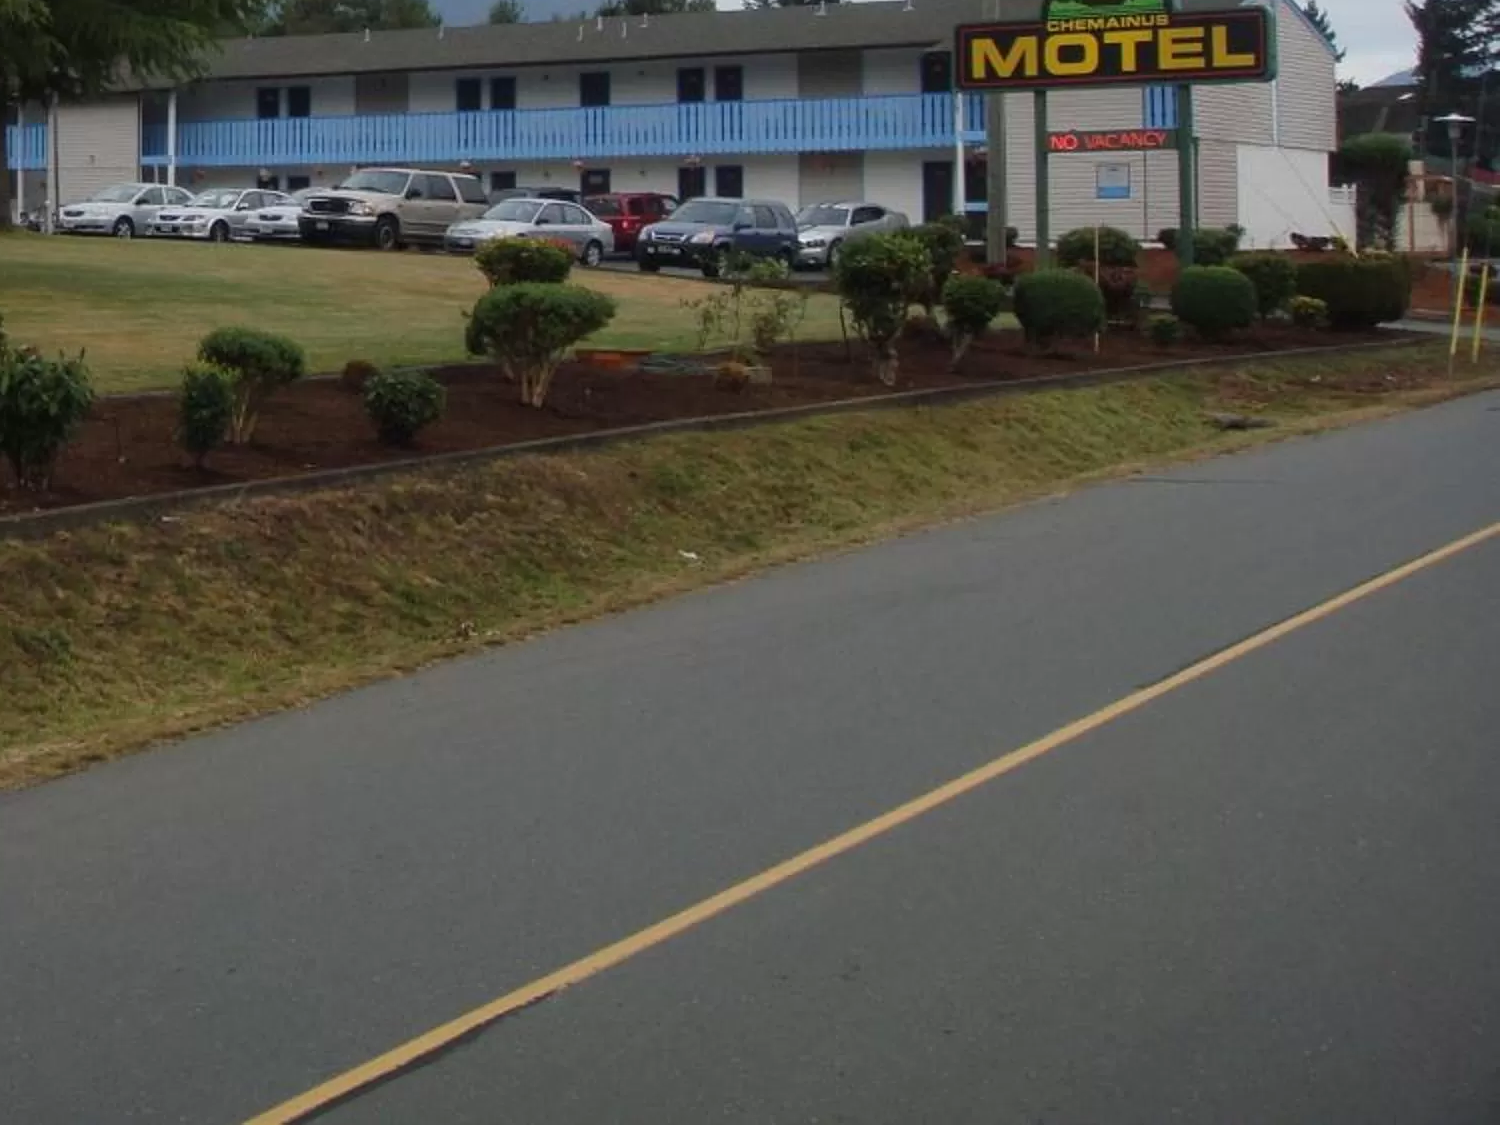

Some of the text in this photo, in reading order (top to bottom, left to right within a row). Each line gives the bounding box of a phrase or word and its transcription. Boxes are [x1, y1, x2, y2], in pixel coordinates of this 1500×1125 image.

[1047, 14, 1169, 32] CHEMAINUS
[971, 25, 1255, 78] MOTEL
[1050, 132, 1167, 150] NO VACANCY
